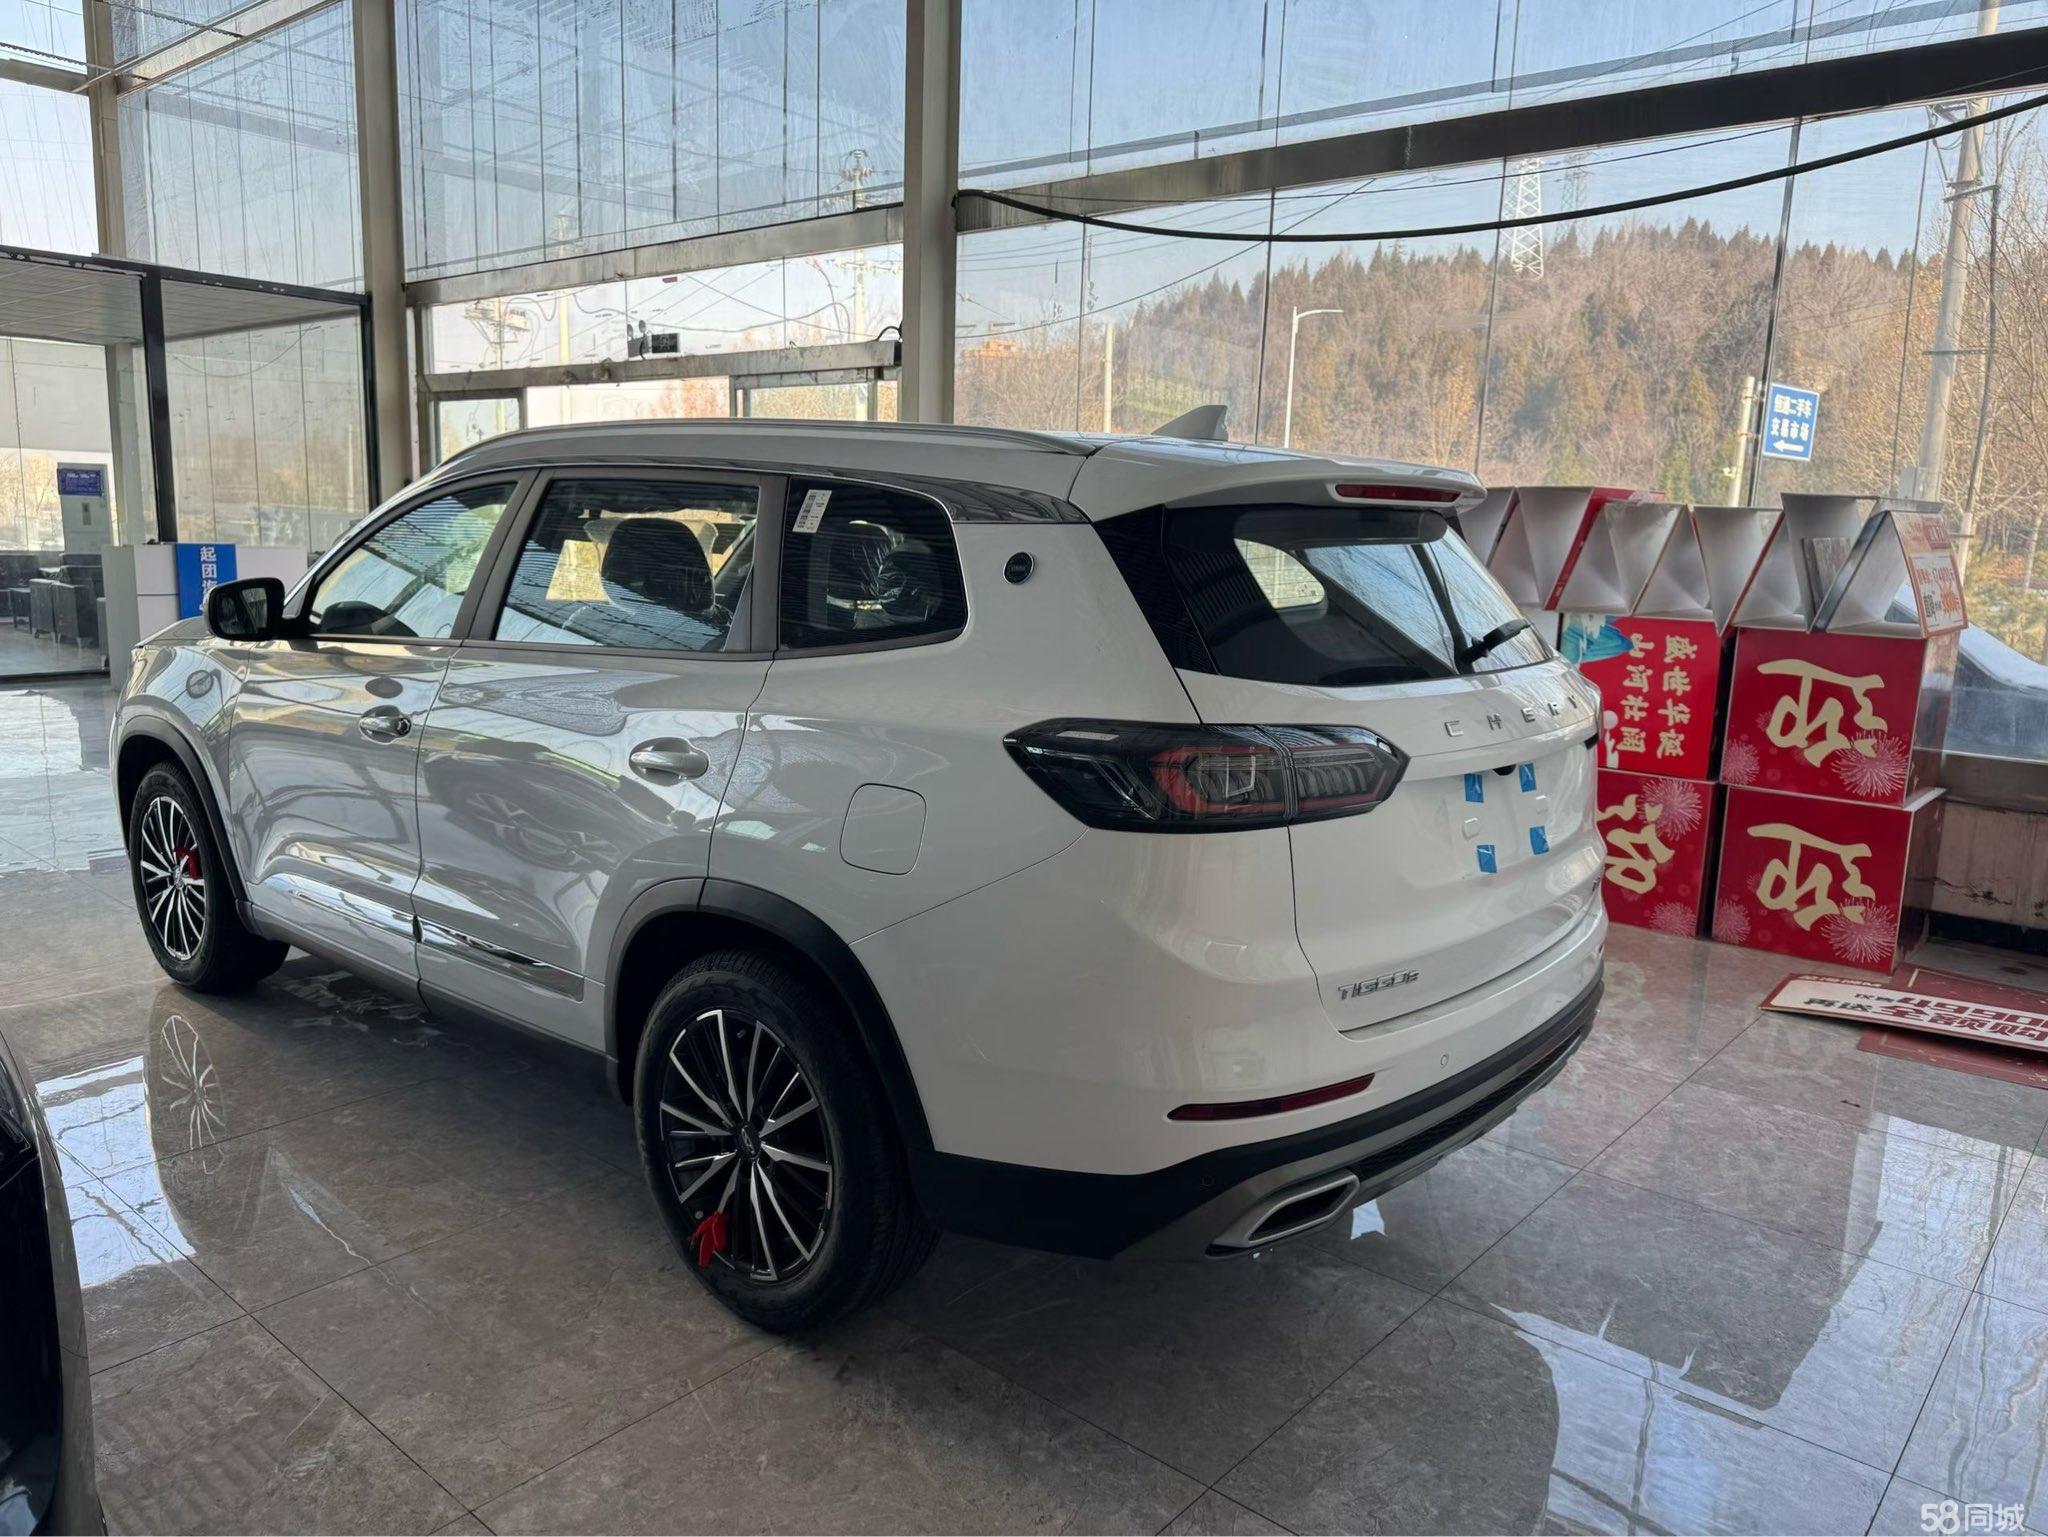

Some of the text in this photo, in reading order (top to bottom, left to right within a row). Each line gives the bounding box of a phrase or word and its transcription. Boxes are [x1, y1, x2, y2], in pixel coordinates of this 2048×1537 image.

[1444, 694, 1580, 737] CHERY
[1616, 632, 1655, 753] 山河壮阔
[1656, 634, 1698, 759] 盛世华诞
